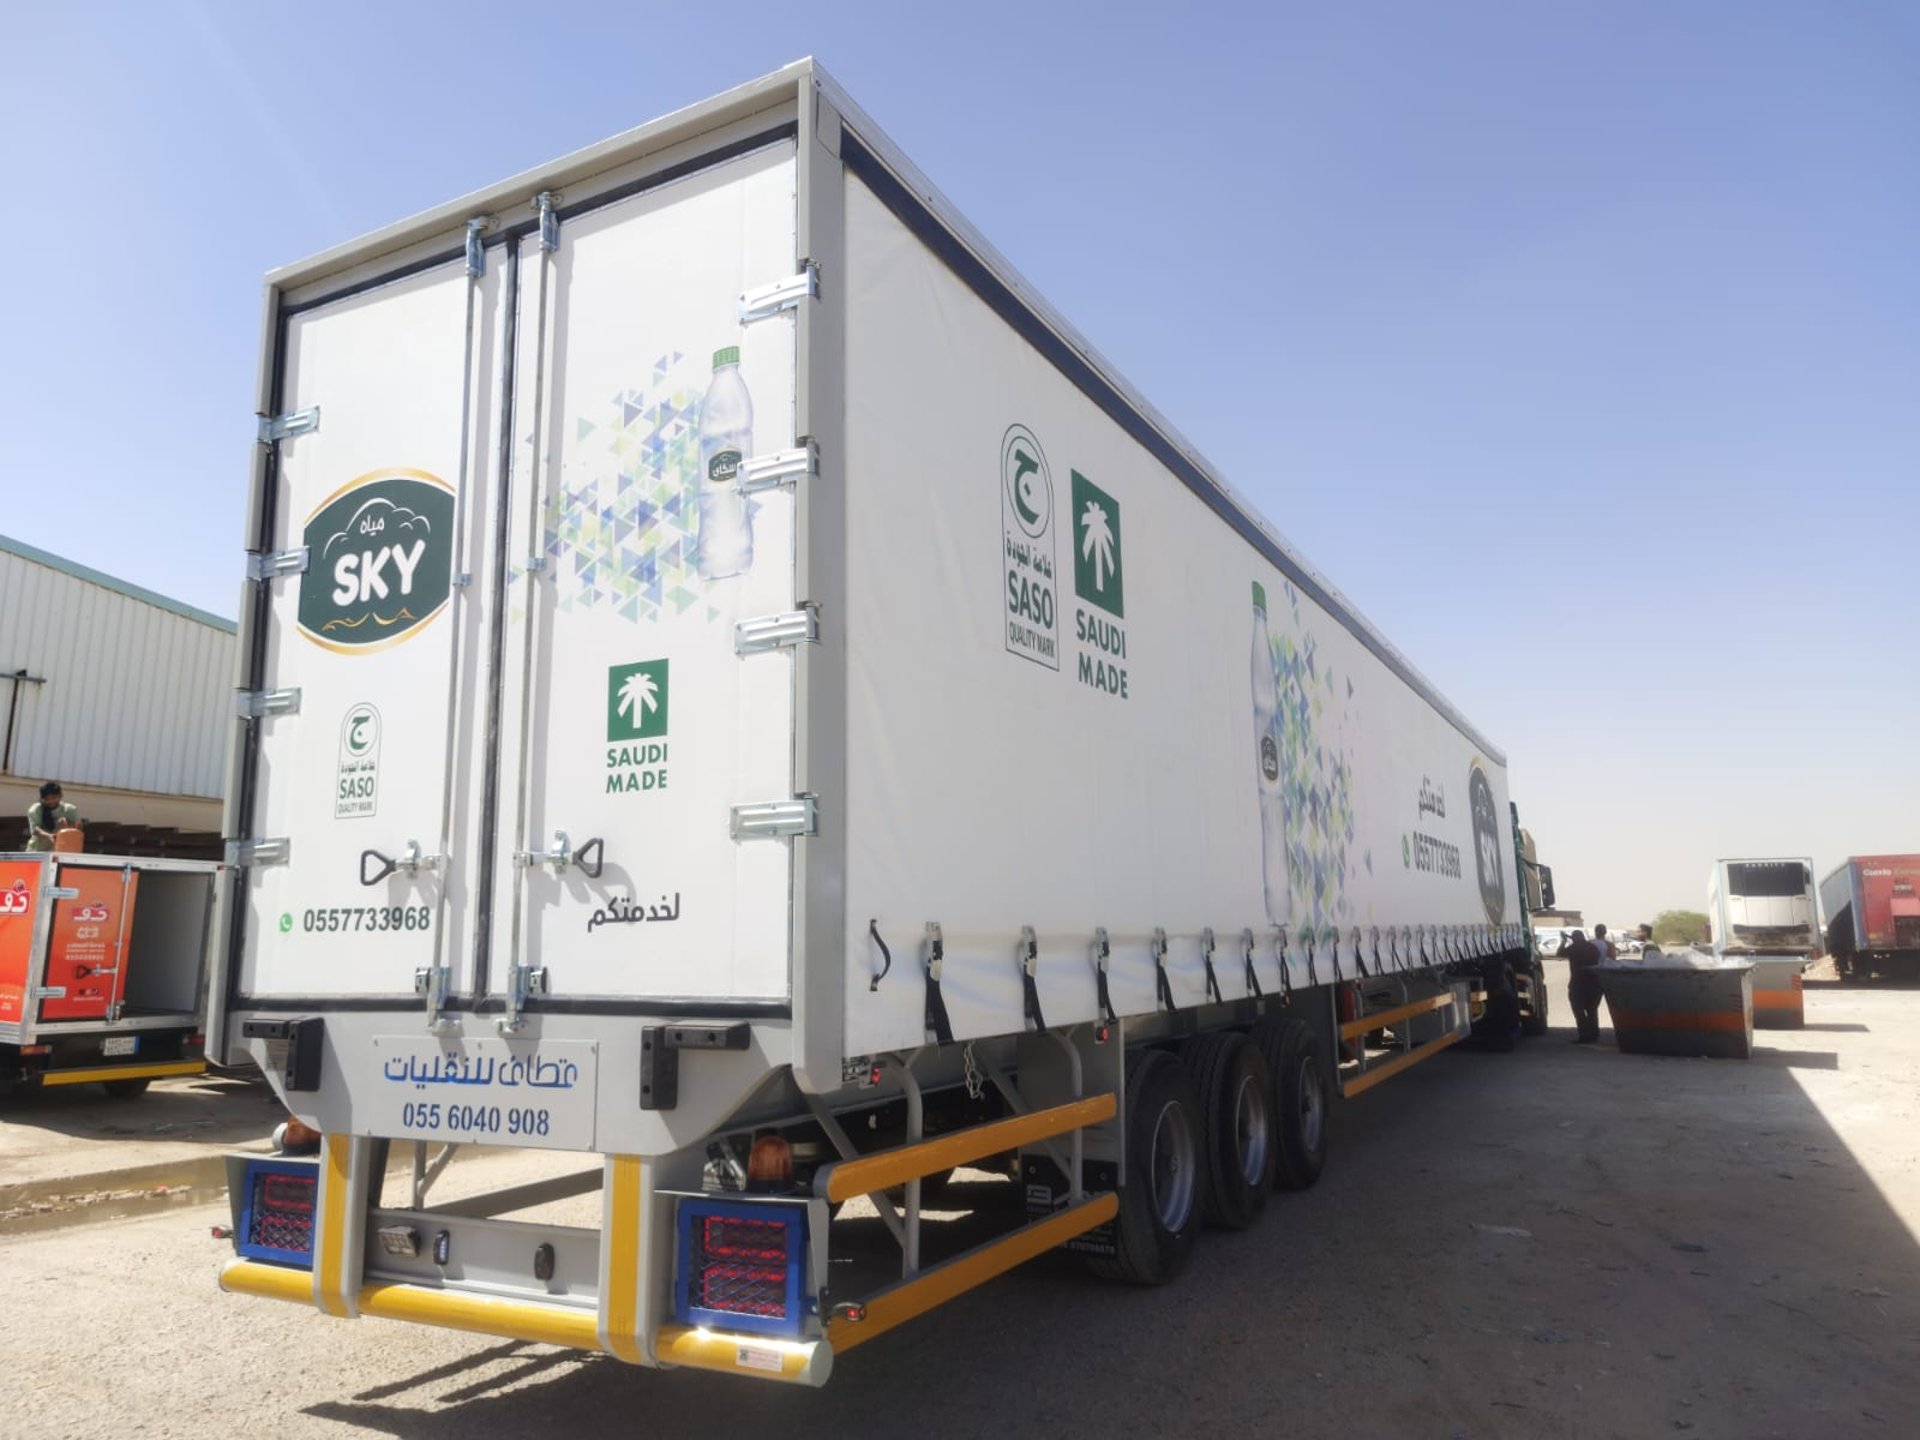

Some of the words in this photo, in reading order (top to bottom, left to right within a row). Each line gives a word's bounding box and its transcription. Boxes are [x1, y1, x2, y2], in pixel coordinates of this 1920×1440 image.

[360, 515, 385, 536] مياه
[332, 539, 426, 607] SKY
[1008, 569, 1054, 630] SASO
[1009, 620, 1037, 651] QUALITY
[1036, 632, 1056, 660] MARK
[1075, 608, 1127, 660] SAUDI
[1078, 651, 1129, 701] MADE
[606, 742, 669, 769] SAUDI
[339, 776, 375, 800] SASO
[605, 768, 668, 794] MADE
[1418, 773, 1446, 821] لخدمتكم
[1413, 831, 1461, 879] 0557733968
[303, 905, 431, 933] 0557733968
[587, 891, 681, 933] لخدمتكم
[383, 1050, 494, 1091] للنقليات
[498, 1054, 579, 1089] قطاف
[402, 1101, 441, 1130] 055
[447, 1104, 501, 1133] 6040
[508, 1106, 551, 1137] 908
